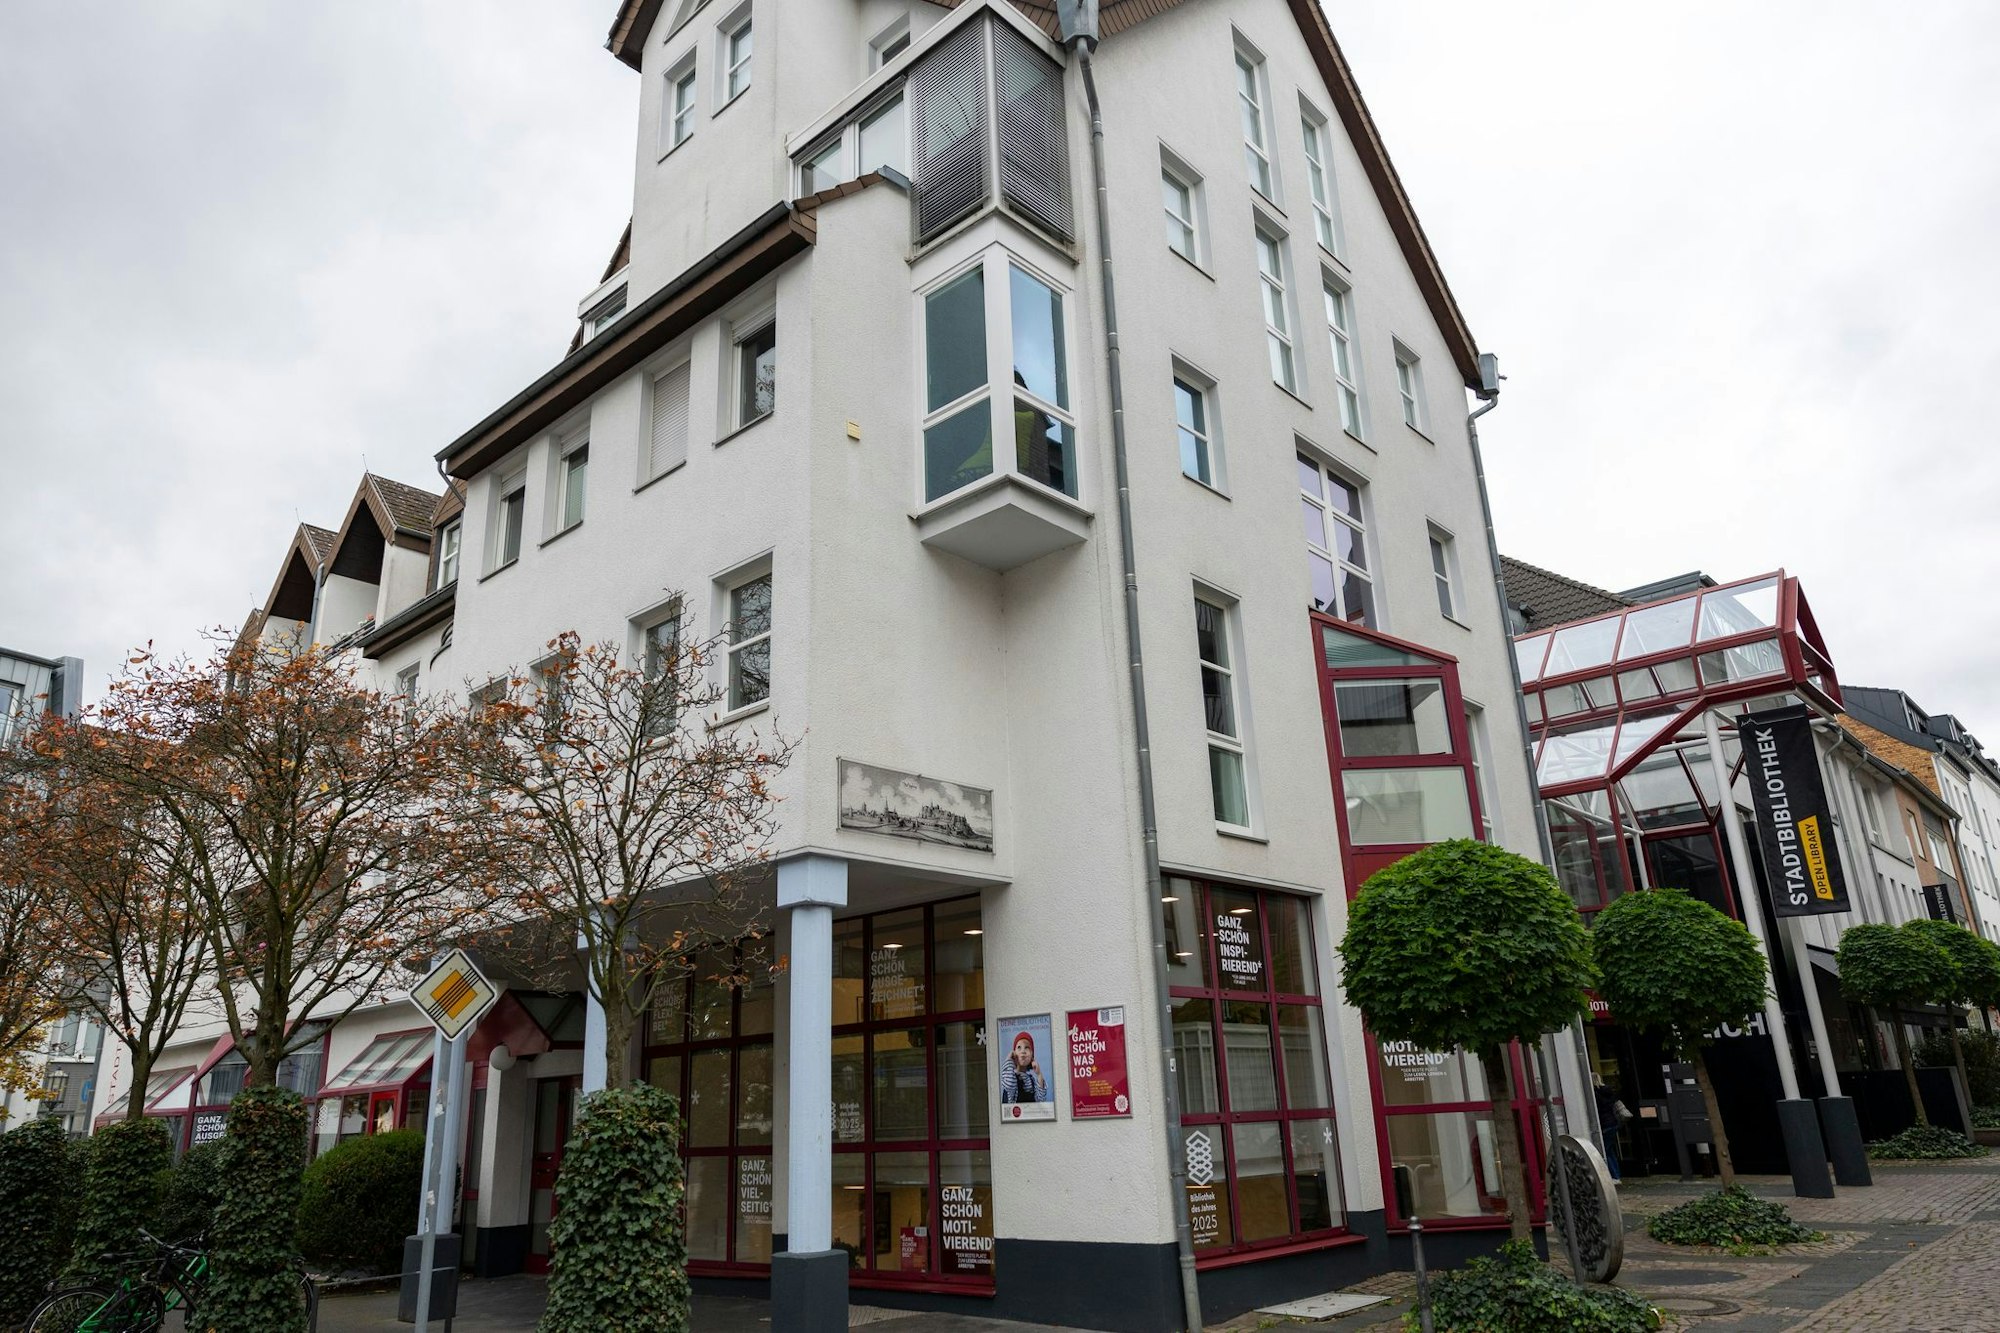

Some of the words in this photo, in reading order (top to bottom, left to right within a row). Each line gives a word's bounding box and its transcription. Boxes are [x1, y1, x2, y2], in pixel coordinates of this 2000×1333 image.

[1755, 727, 1808, 905] STADTBIBLIOTHEK
[1805, 823, 1823, 864] LIBRARY
[1814, 869, 1828, 894] OPEN
[1217, 914, 1242, 929] GANZ
[1219, 929, 1249, 944] SCHÖN
[871, 948, 898, 962] GANZ
[1220, 943, 1247, 958] INSPI-
[871, 959, 905, 976] SCHÖN
[1072, 1030, 1099, 1042] GANZ
[1073, 1040, 1106, 1054] SCHÖN
[1073, 1055, 1095, 1066] WAS
[198, 1115, 222, 1124] GANZ
[840, 1118, 860, 1129] 2025
[196, 1122, 227, 1132] SCHÖN
[741, 1160, 766, 1171] GANZ
[741, 1171, 772, 1185] SCHÖN
[741, 1187, 763, 1199] VIEL-
[942, 1188, 973, 1201] GANZ
[1190, 1192, 1215, 1202] Bibliothek
[942, 1202, 982, 1217] SCHÖN
[1191, 1204, 1200, 1213] des
[1201, 1203, 1217, 1212] Jahres
[942, 1220, 977, 1234] MOTI-
[1192, 1214, 1218, 1231] 2025
